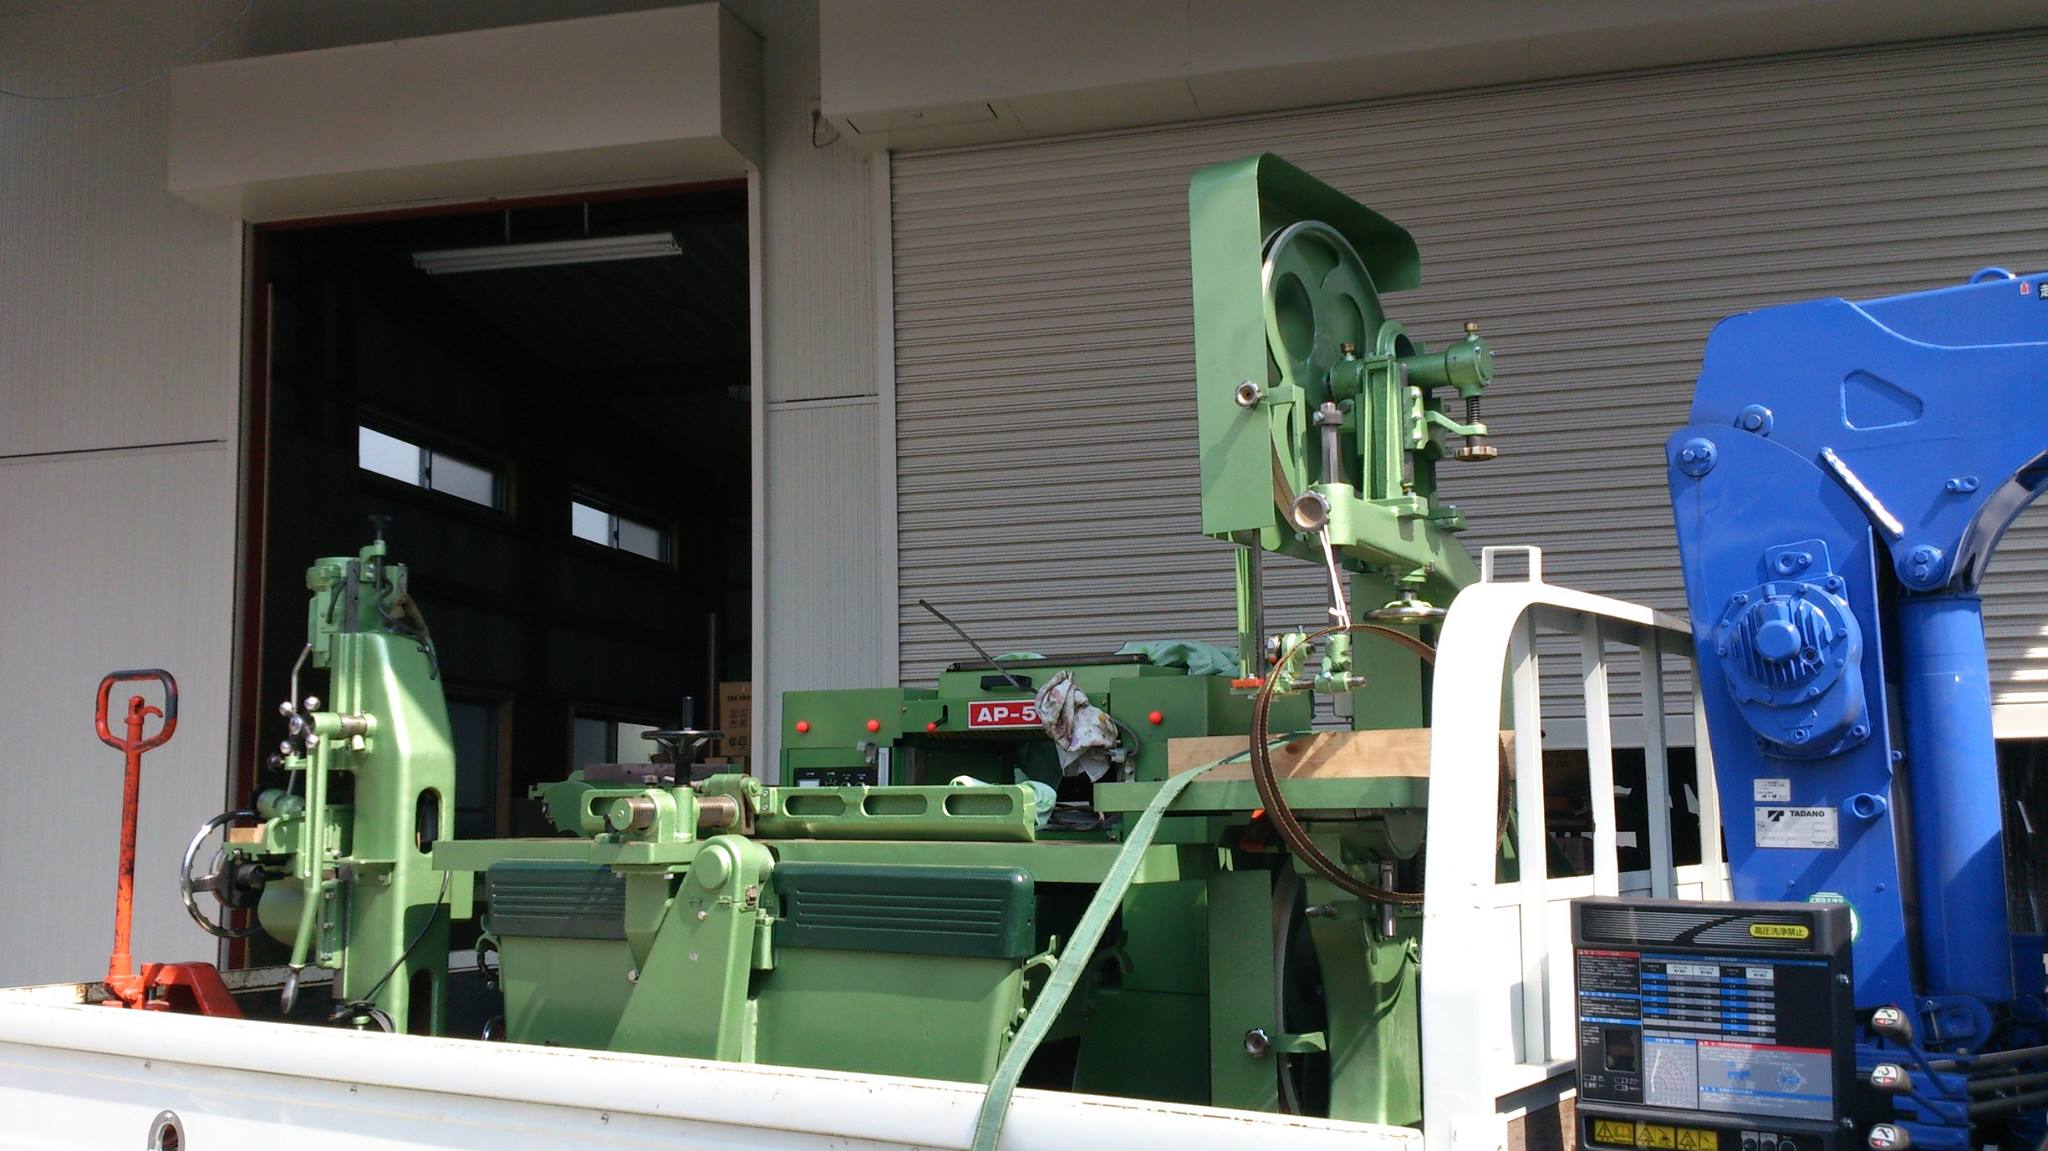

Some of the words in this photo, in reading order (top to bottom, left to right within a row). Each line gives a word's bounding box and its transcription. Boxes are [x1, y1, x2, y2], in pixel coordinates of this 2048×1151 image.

[1789, 810, 1825, 818] TADANO
[1754, 926, 1805, 937] 高圧洗浄禁止
